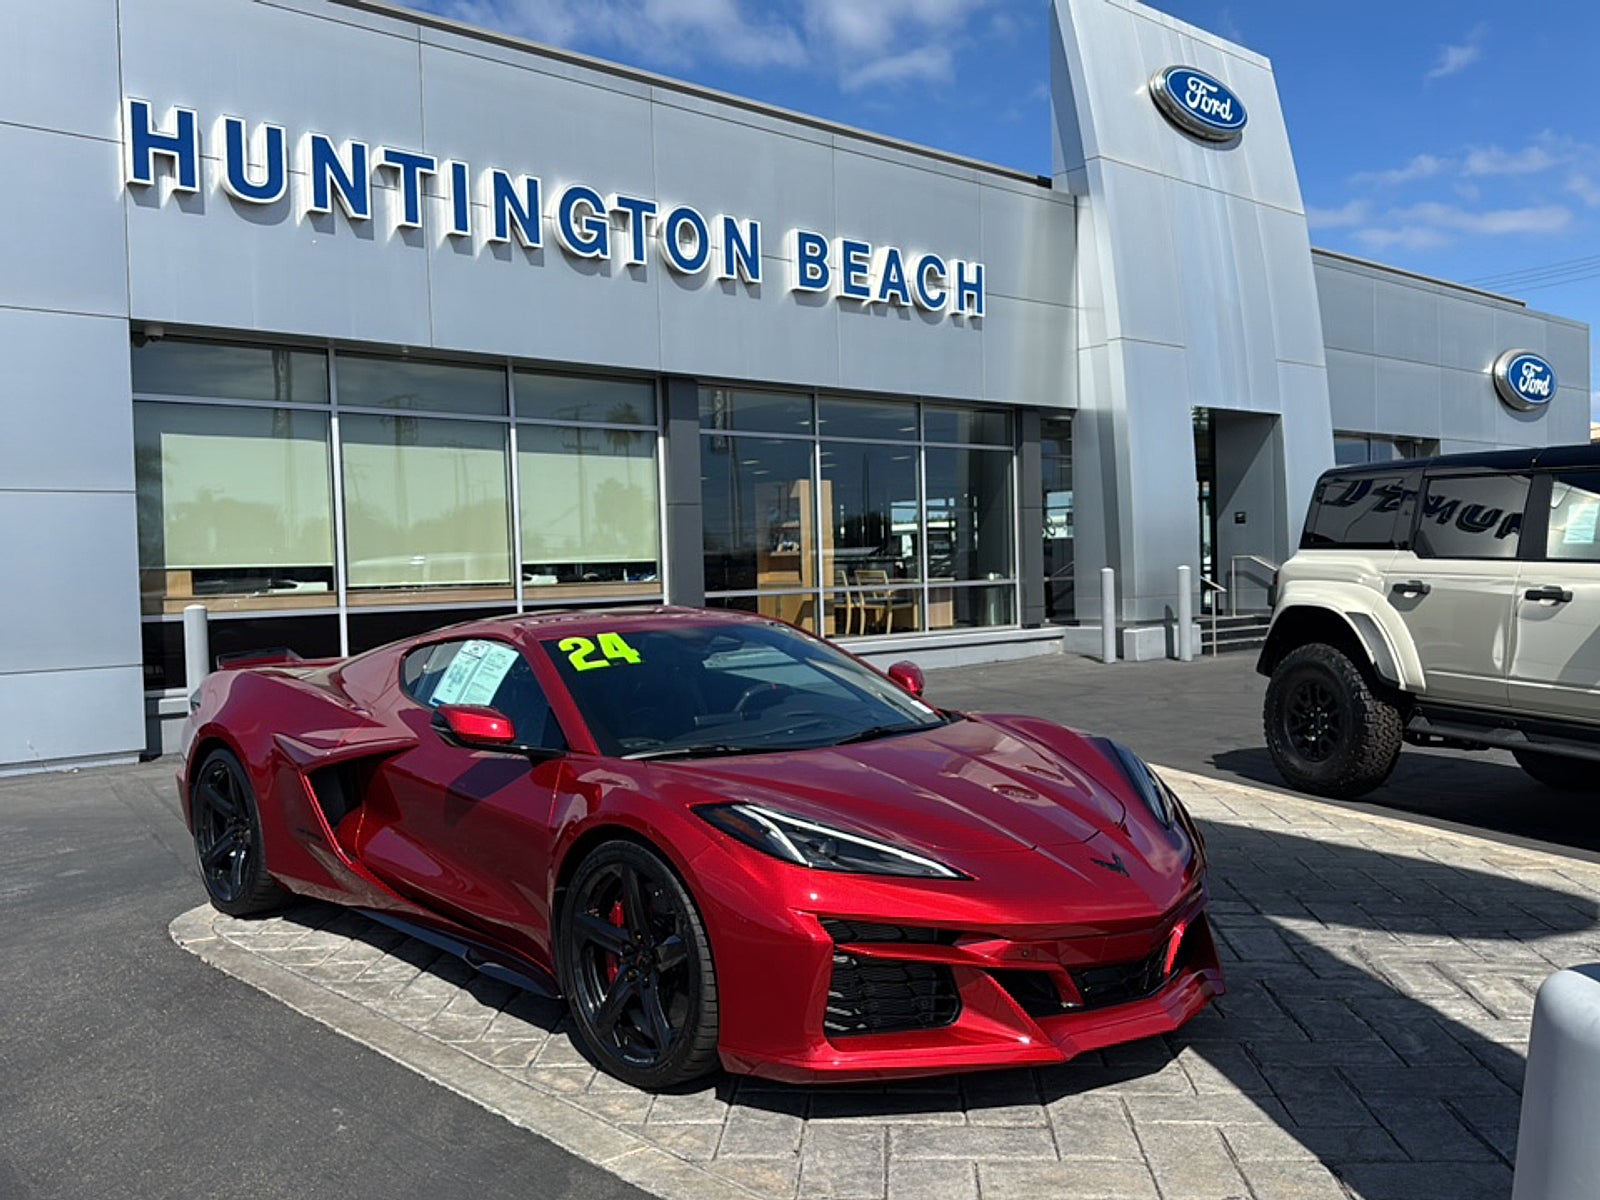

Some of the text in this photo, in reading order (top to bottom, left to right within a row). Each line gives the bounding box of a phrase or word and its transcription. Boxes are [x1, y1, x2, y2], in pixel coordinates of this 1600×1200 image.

[1185, 76, 1233, 121] Ford
[127, 97, 985, 317] HUNTINGTON BEACH
[1518, 361, 1551, 396] Ford
[558, 632, 641, 672] 24
